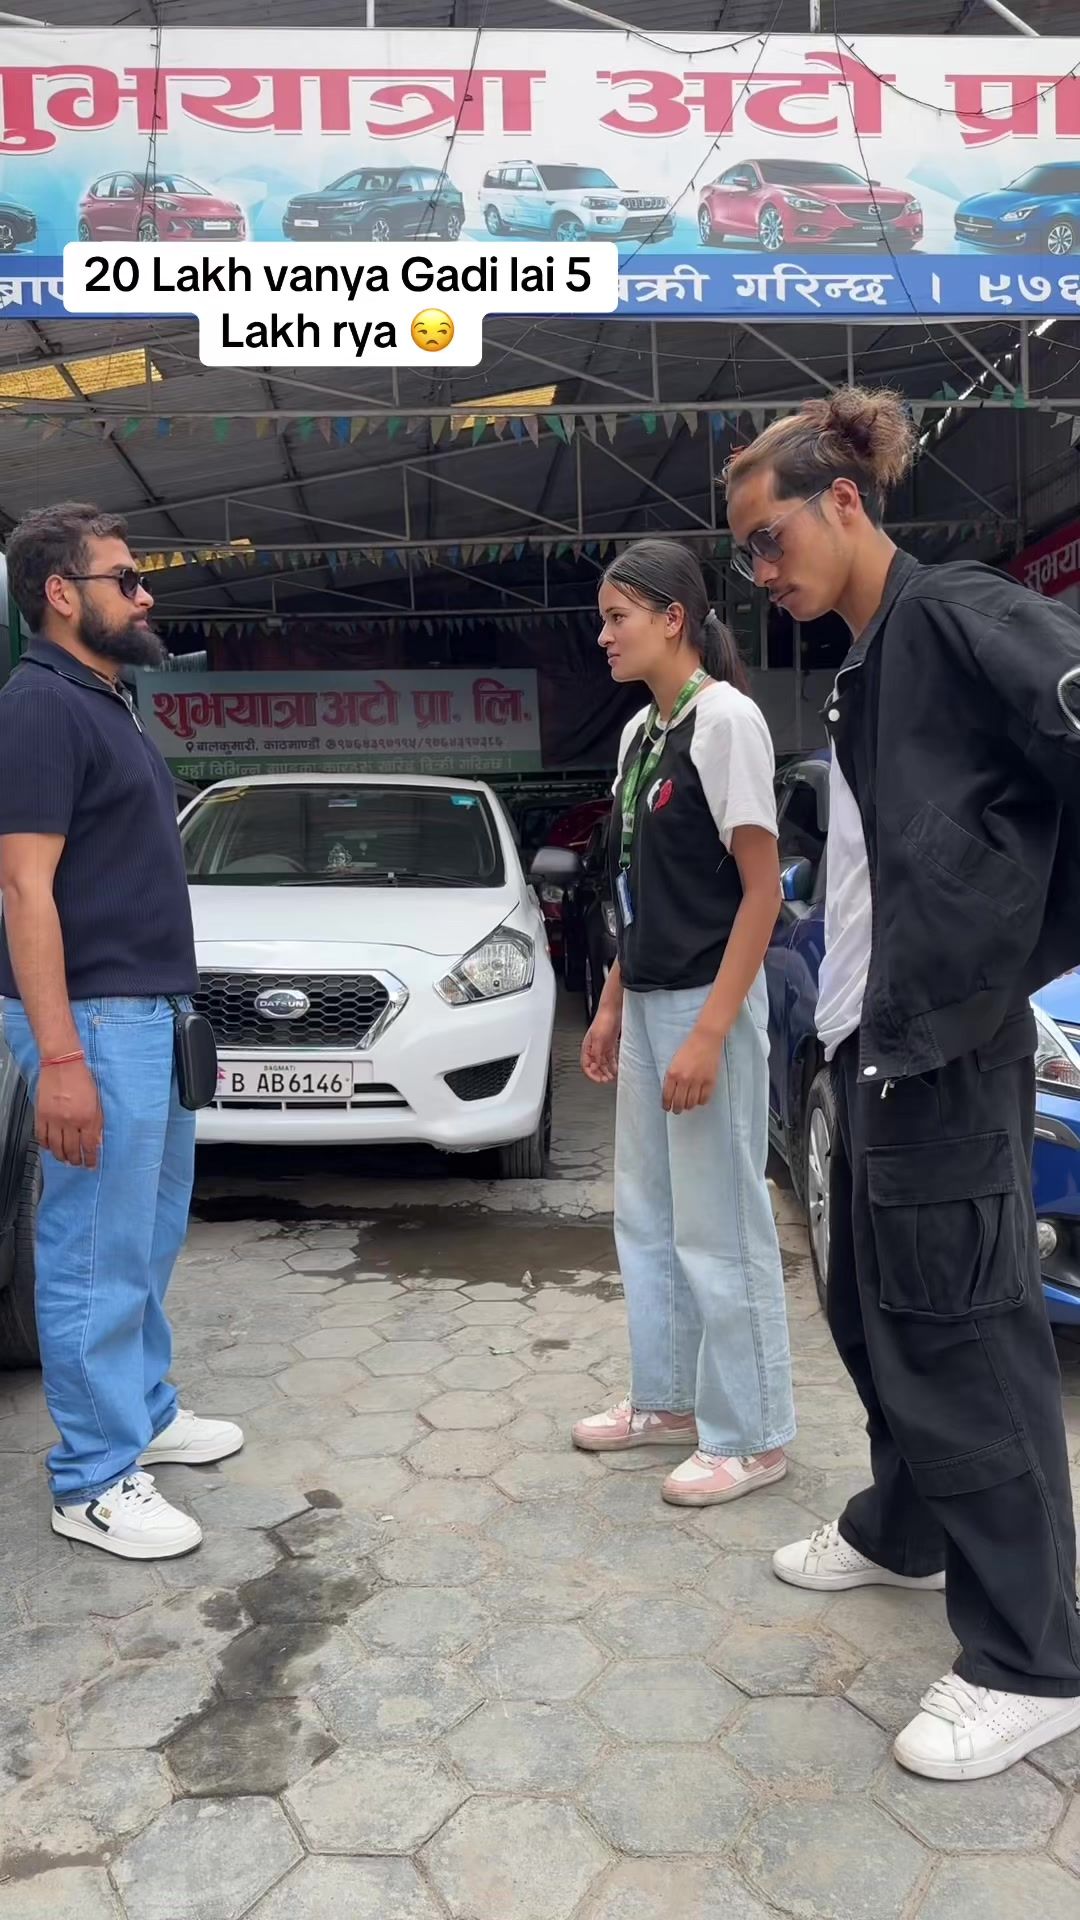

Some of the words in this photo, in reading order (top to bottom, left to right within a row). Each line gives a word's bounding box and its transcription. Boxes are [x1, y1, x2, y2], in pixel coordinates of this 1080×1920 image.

[596, 52, 896, 138] अटो
[732, 263, 894, 307] गरिन्छ
[152, 691, 318, 740] शुभयात्रा
[321, 679, 400, 727] अटो
[472, 677, 532, 726] लि.
[259, 1000, 304, 1008] DATSUN
[232, 1073, 245, 1093] B
